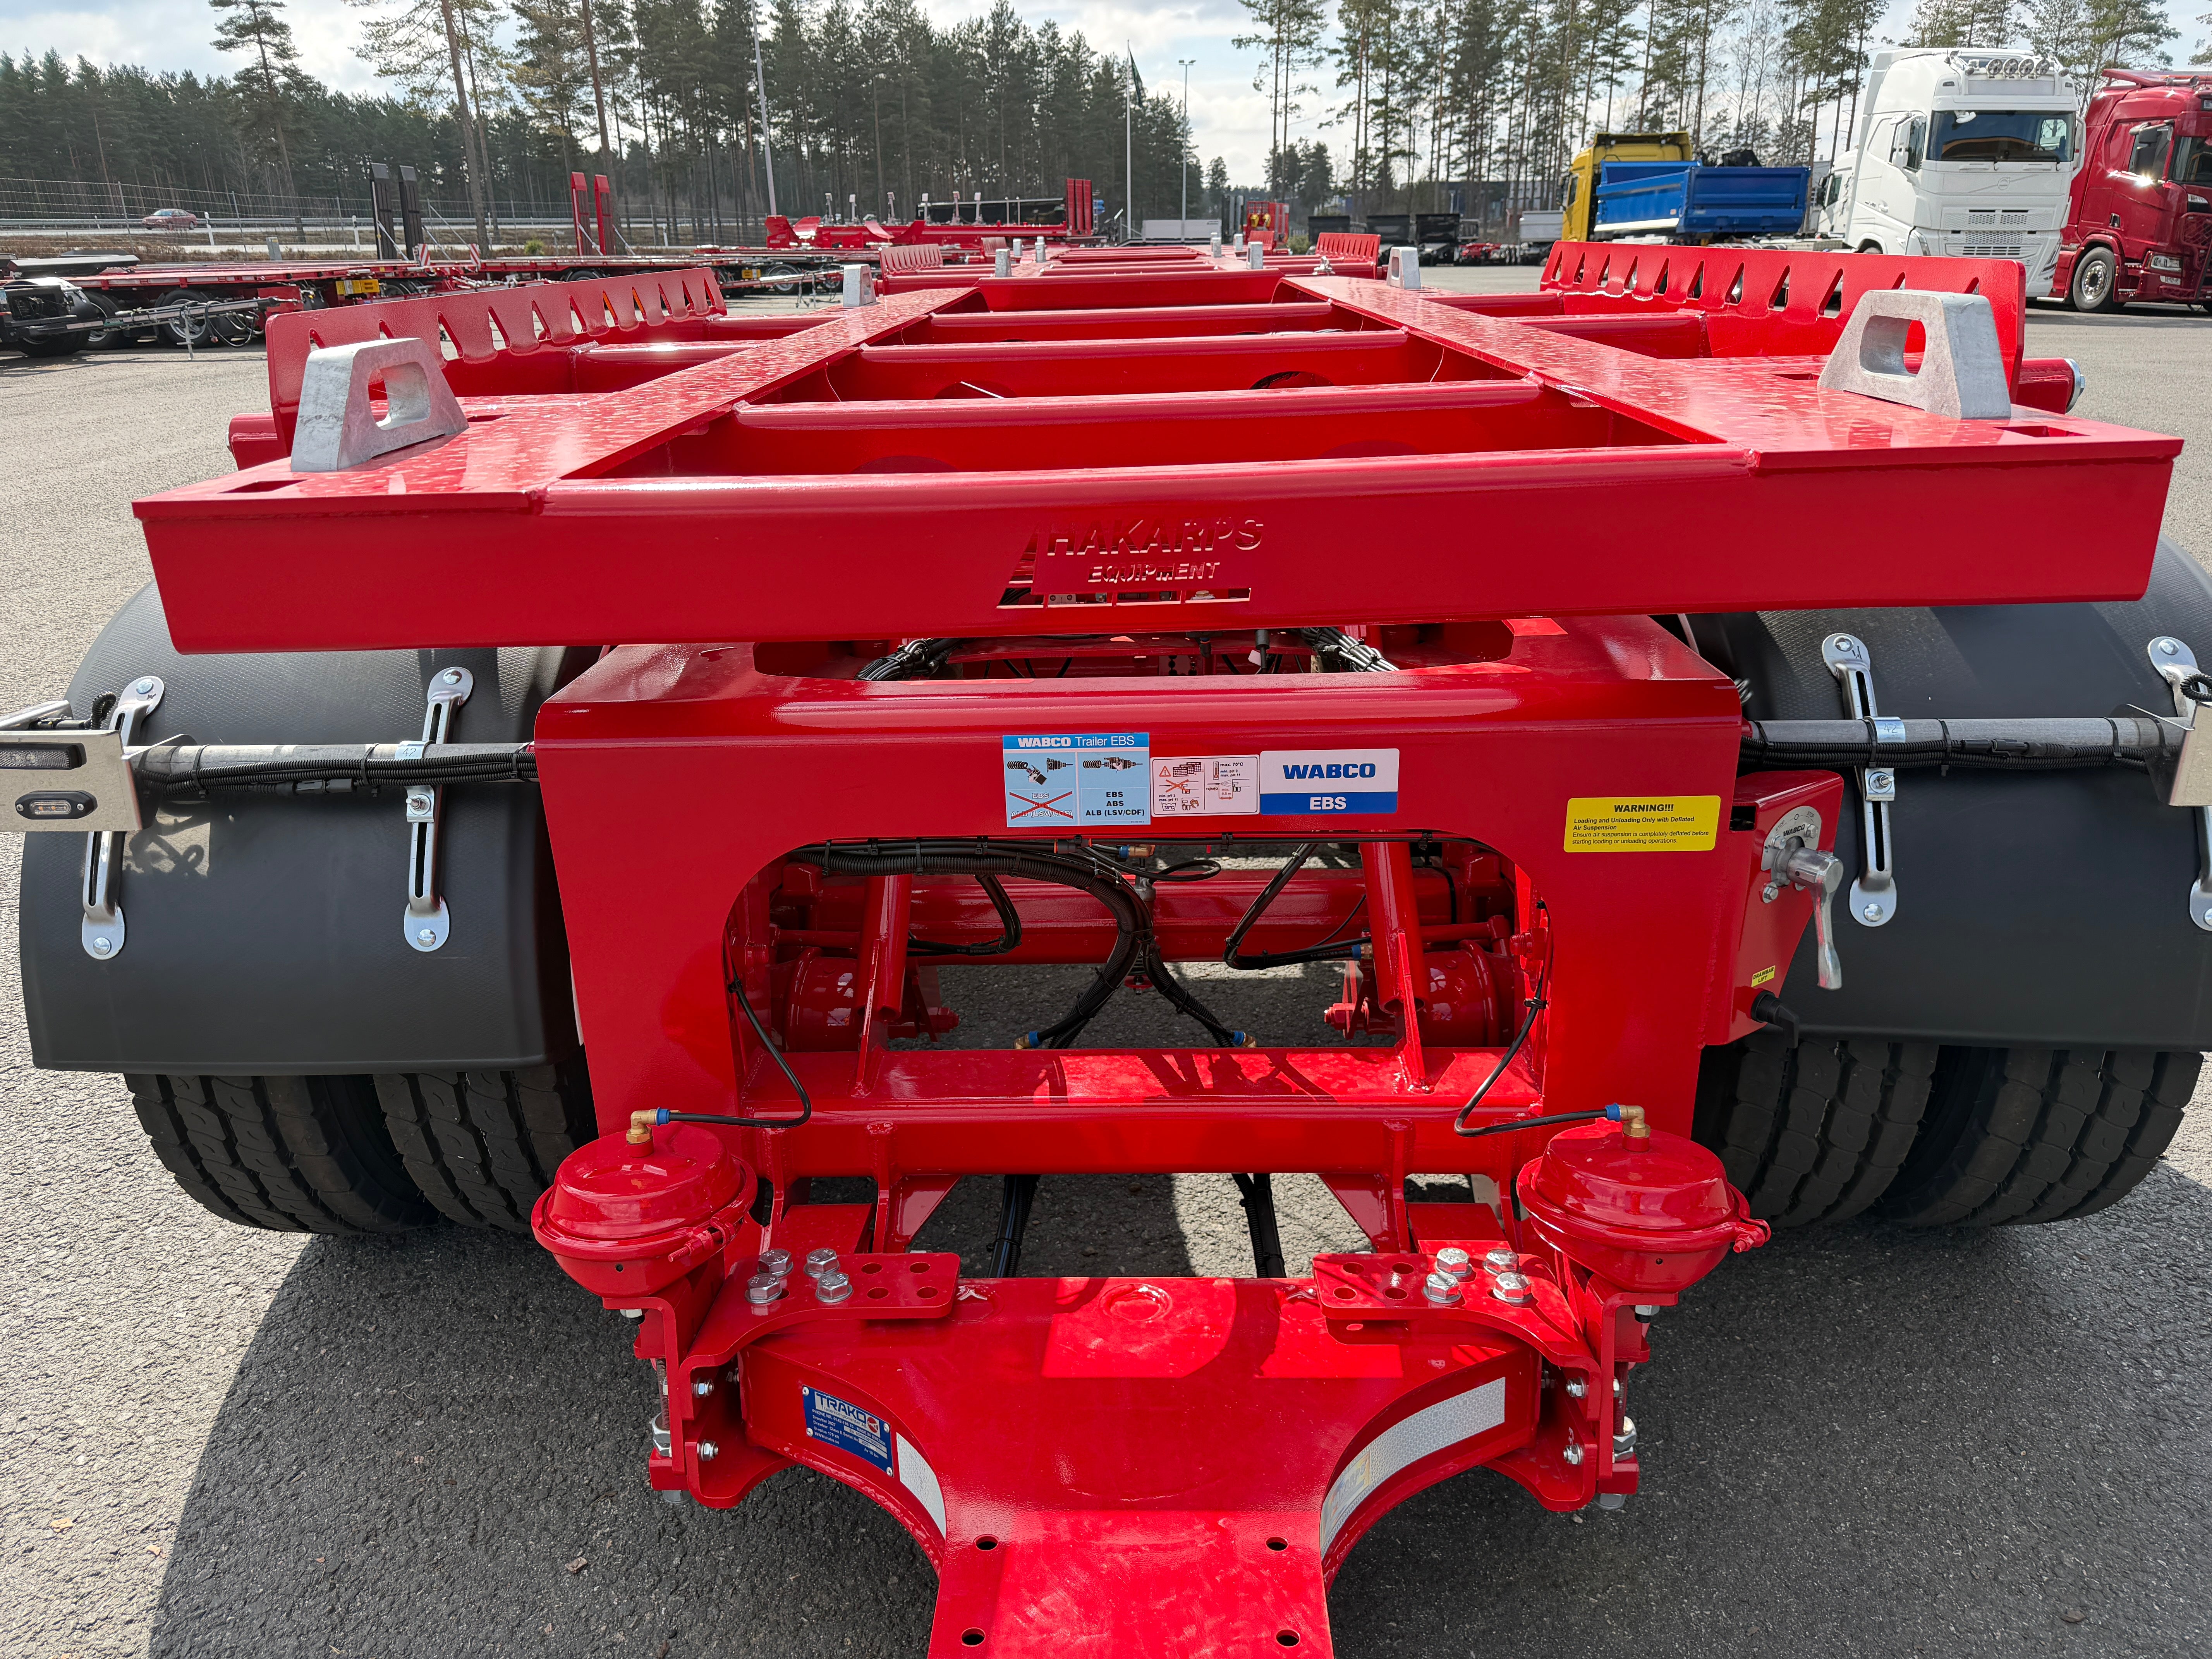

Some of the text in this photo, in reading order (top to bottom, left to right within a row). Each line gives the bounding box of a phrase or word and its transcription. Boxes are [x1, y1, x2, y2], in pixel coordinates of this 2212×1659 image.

[1047, 517, 1264, 556] HAKARPS
[1088, 562, 1220, 583] EQUIPMENT
[1884, 723, 1898, 733] 42
[1018, 735, 1134, 747] WABCO Trailer EBS
[403, 748, 416, 757] 42
[1283, 763, 1376, 779] WABCO
[1310, 796, 1346, 810] EBS
[1614, 804, 1674, 812] WARNING!!!
[1104, 809, 1145, 817] (LSV/CDF)
[1783, 824, 1805, 836] WABCO
[1753, 967, 1774, 980] DRAWBAR
[816, 1393, 867, 1424] TRAKO
